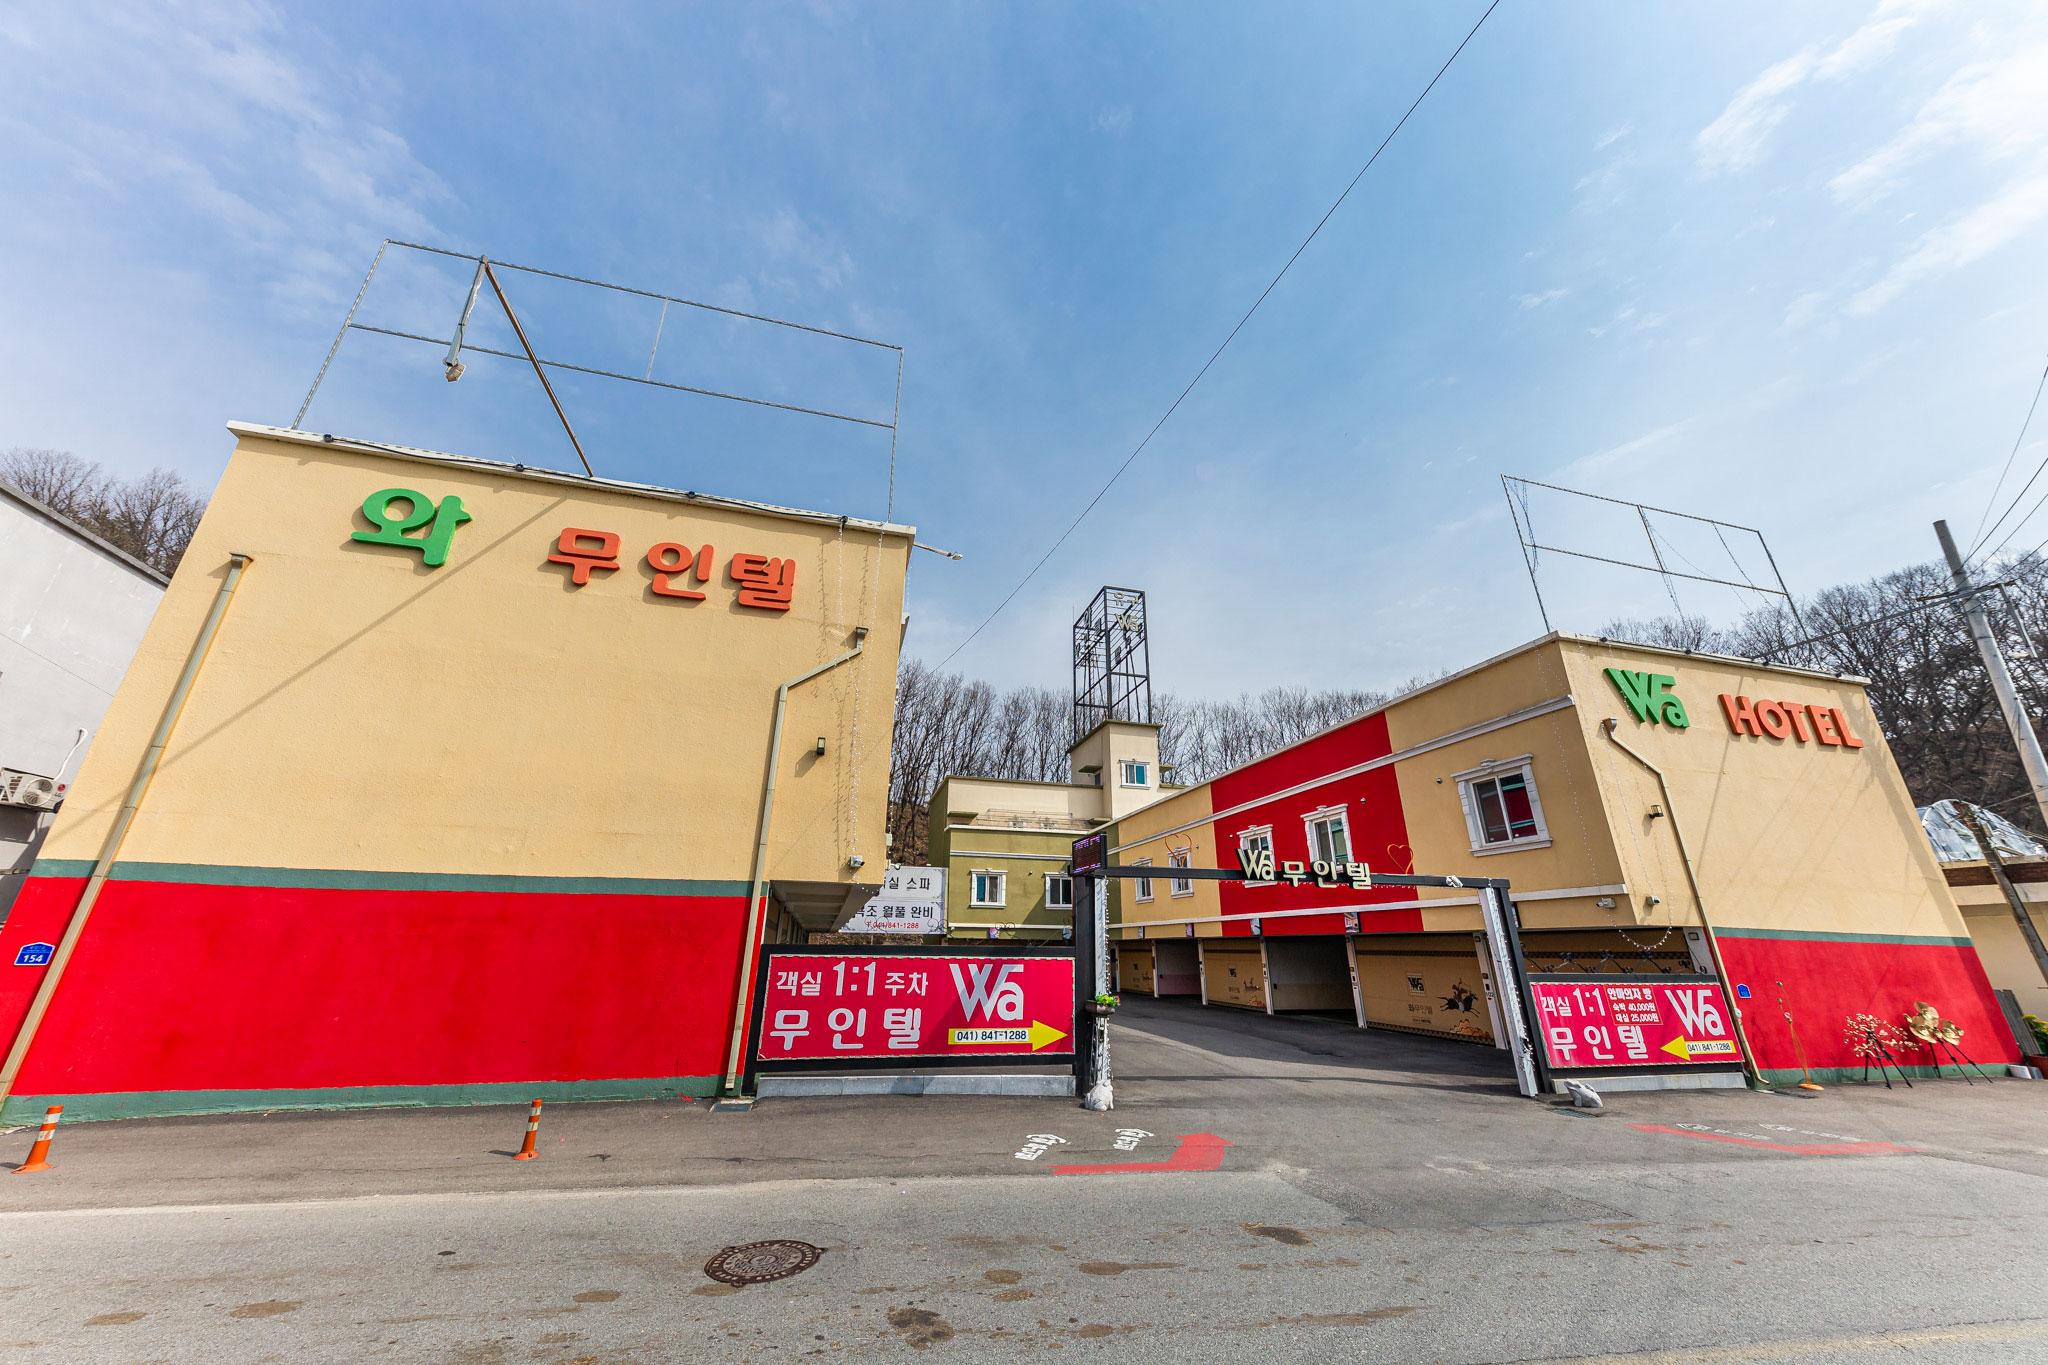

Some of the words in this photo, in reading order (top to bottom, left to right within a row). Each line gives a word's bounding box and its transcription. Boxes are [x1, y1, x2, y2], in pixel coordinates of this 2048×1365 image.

[350, 488, 473, 567] 와
[547, 527, 796, 610] 무인텔
[1603, 668, 1690, 728] Wa
[1718, 693, 1864, 749] HOTEL
[906, 877, 930, 890] 스파
[1236, 848, 1275, 880] Wa
[1282, 860, 1372, 889] 무인텔
[911, 906, 933, 918] 완비
[24, 955, 43, 963] 154
[776, 971, 822, 997] 객실
[832, 961, 876, 996] 1:1
[884, 972, 929, 997] 주차
[949, 963, 1024, 1022] Wa
[1541, 996, 1572, 1017] 객실
[1573, 988, 1605, 1017] 1:1
[1613, 1002, 1626, 1011] 숙박
[1628, 1002, 1656, 1012] 40,000원
[1631, 1012, 1660, 1022] 25,000원
[1664, 989, 1726, 1037] Wa
[770, 1008, 922, 1051] 무인텔
[957, 1031, 978, 1041] 041)
[981, 1030, 1027, 1041] 841-1288
[1551, 1026, 1648, 1060] 무인텔
